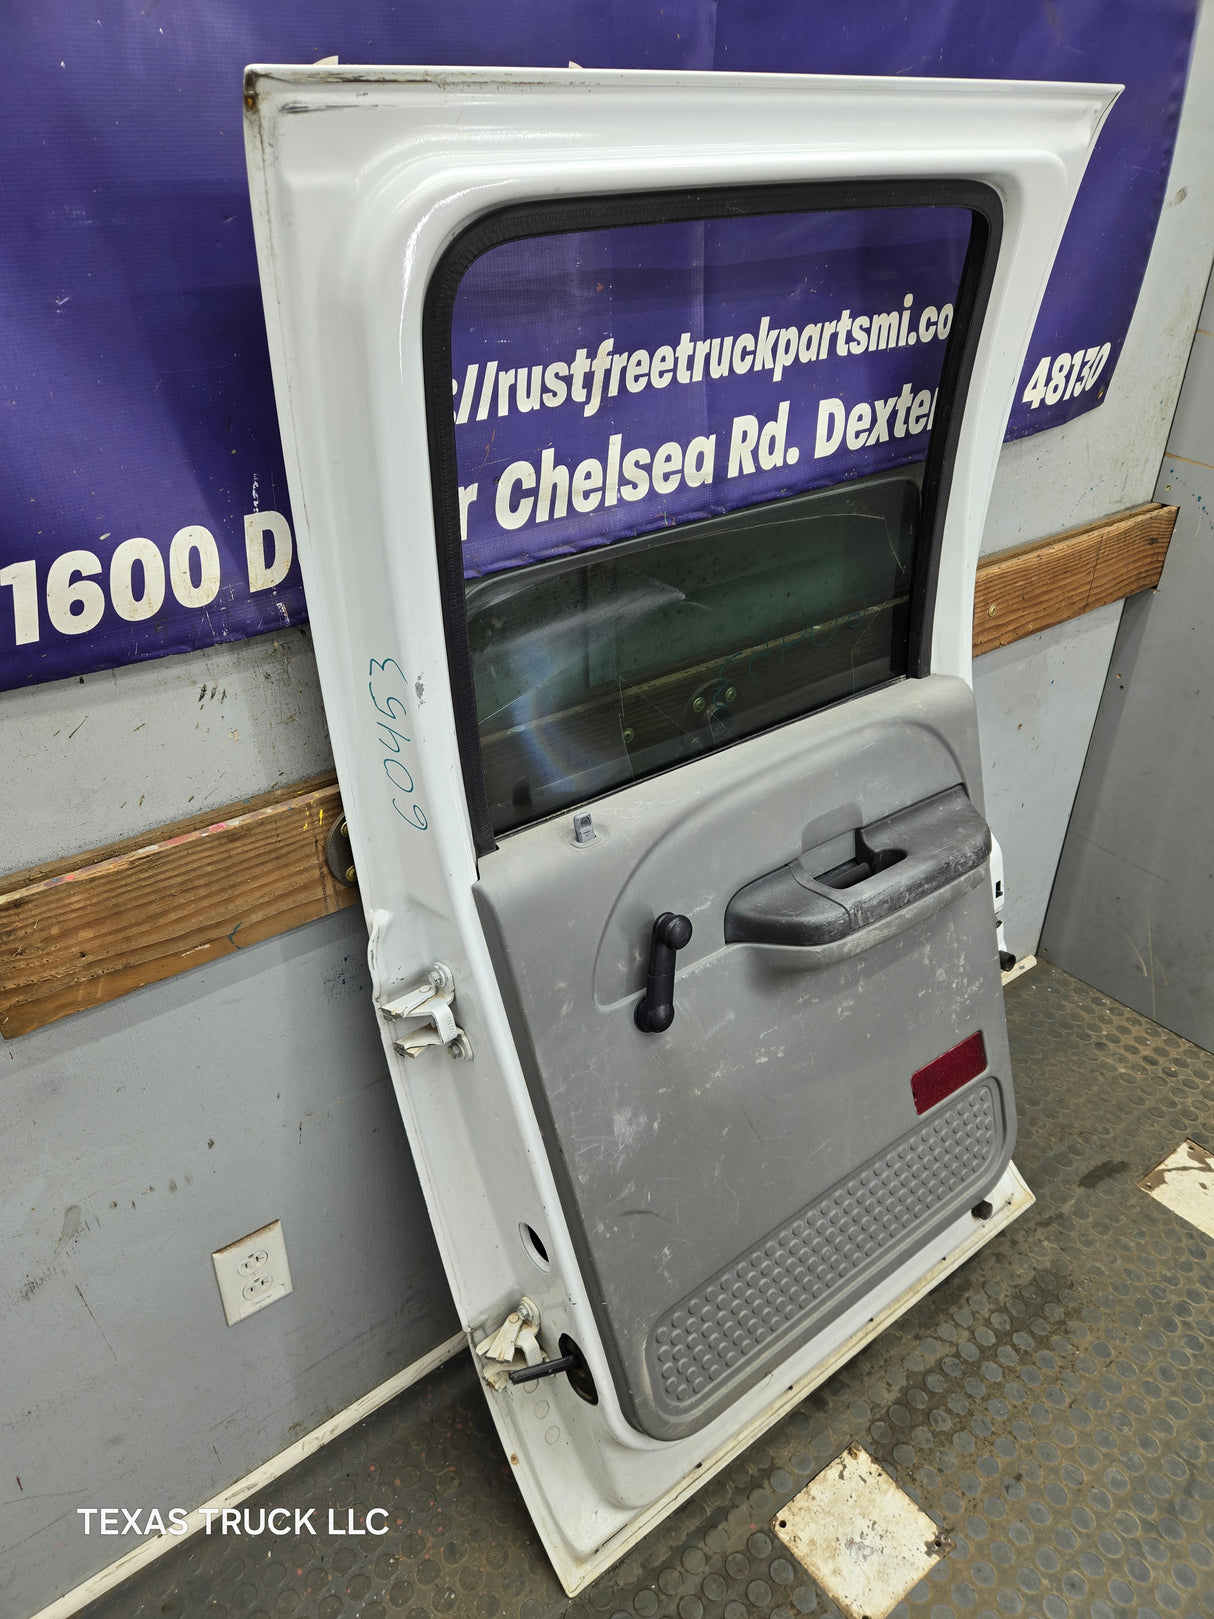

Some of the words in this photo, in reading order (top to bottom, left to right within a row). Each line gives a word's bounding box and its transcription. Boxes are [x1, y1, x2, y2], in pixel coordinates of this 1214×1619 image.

[0, 525, 221, 646] 1600
[495, 433, 717, 531] Chelsea
[728, 400, 800, 479] Rd.
[1022, 342, 1112, 410] 48130
[368, 657, 428, 831] 60453
